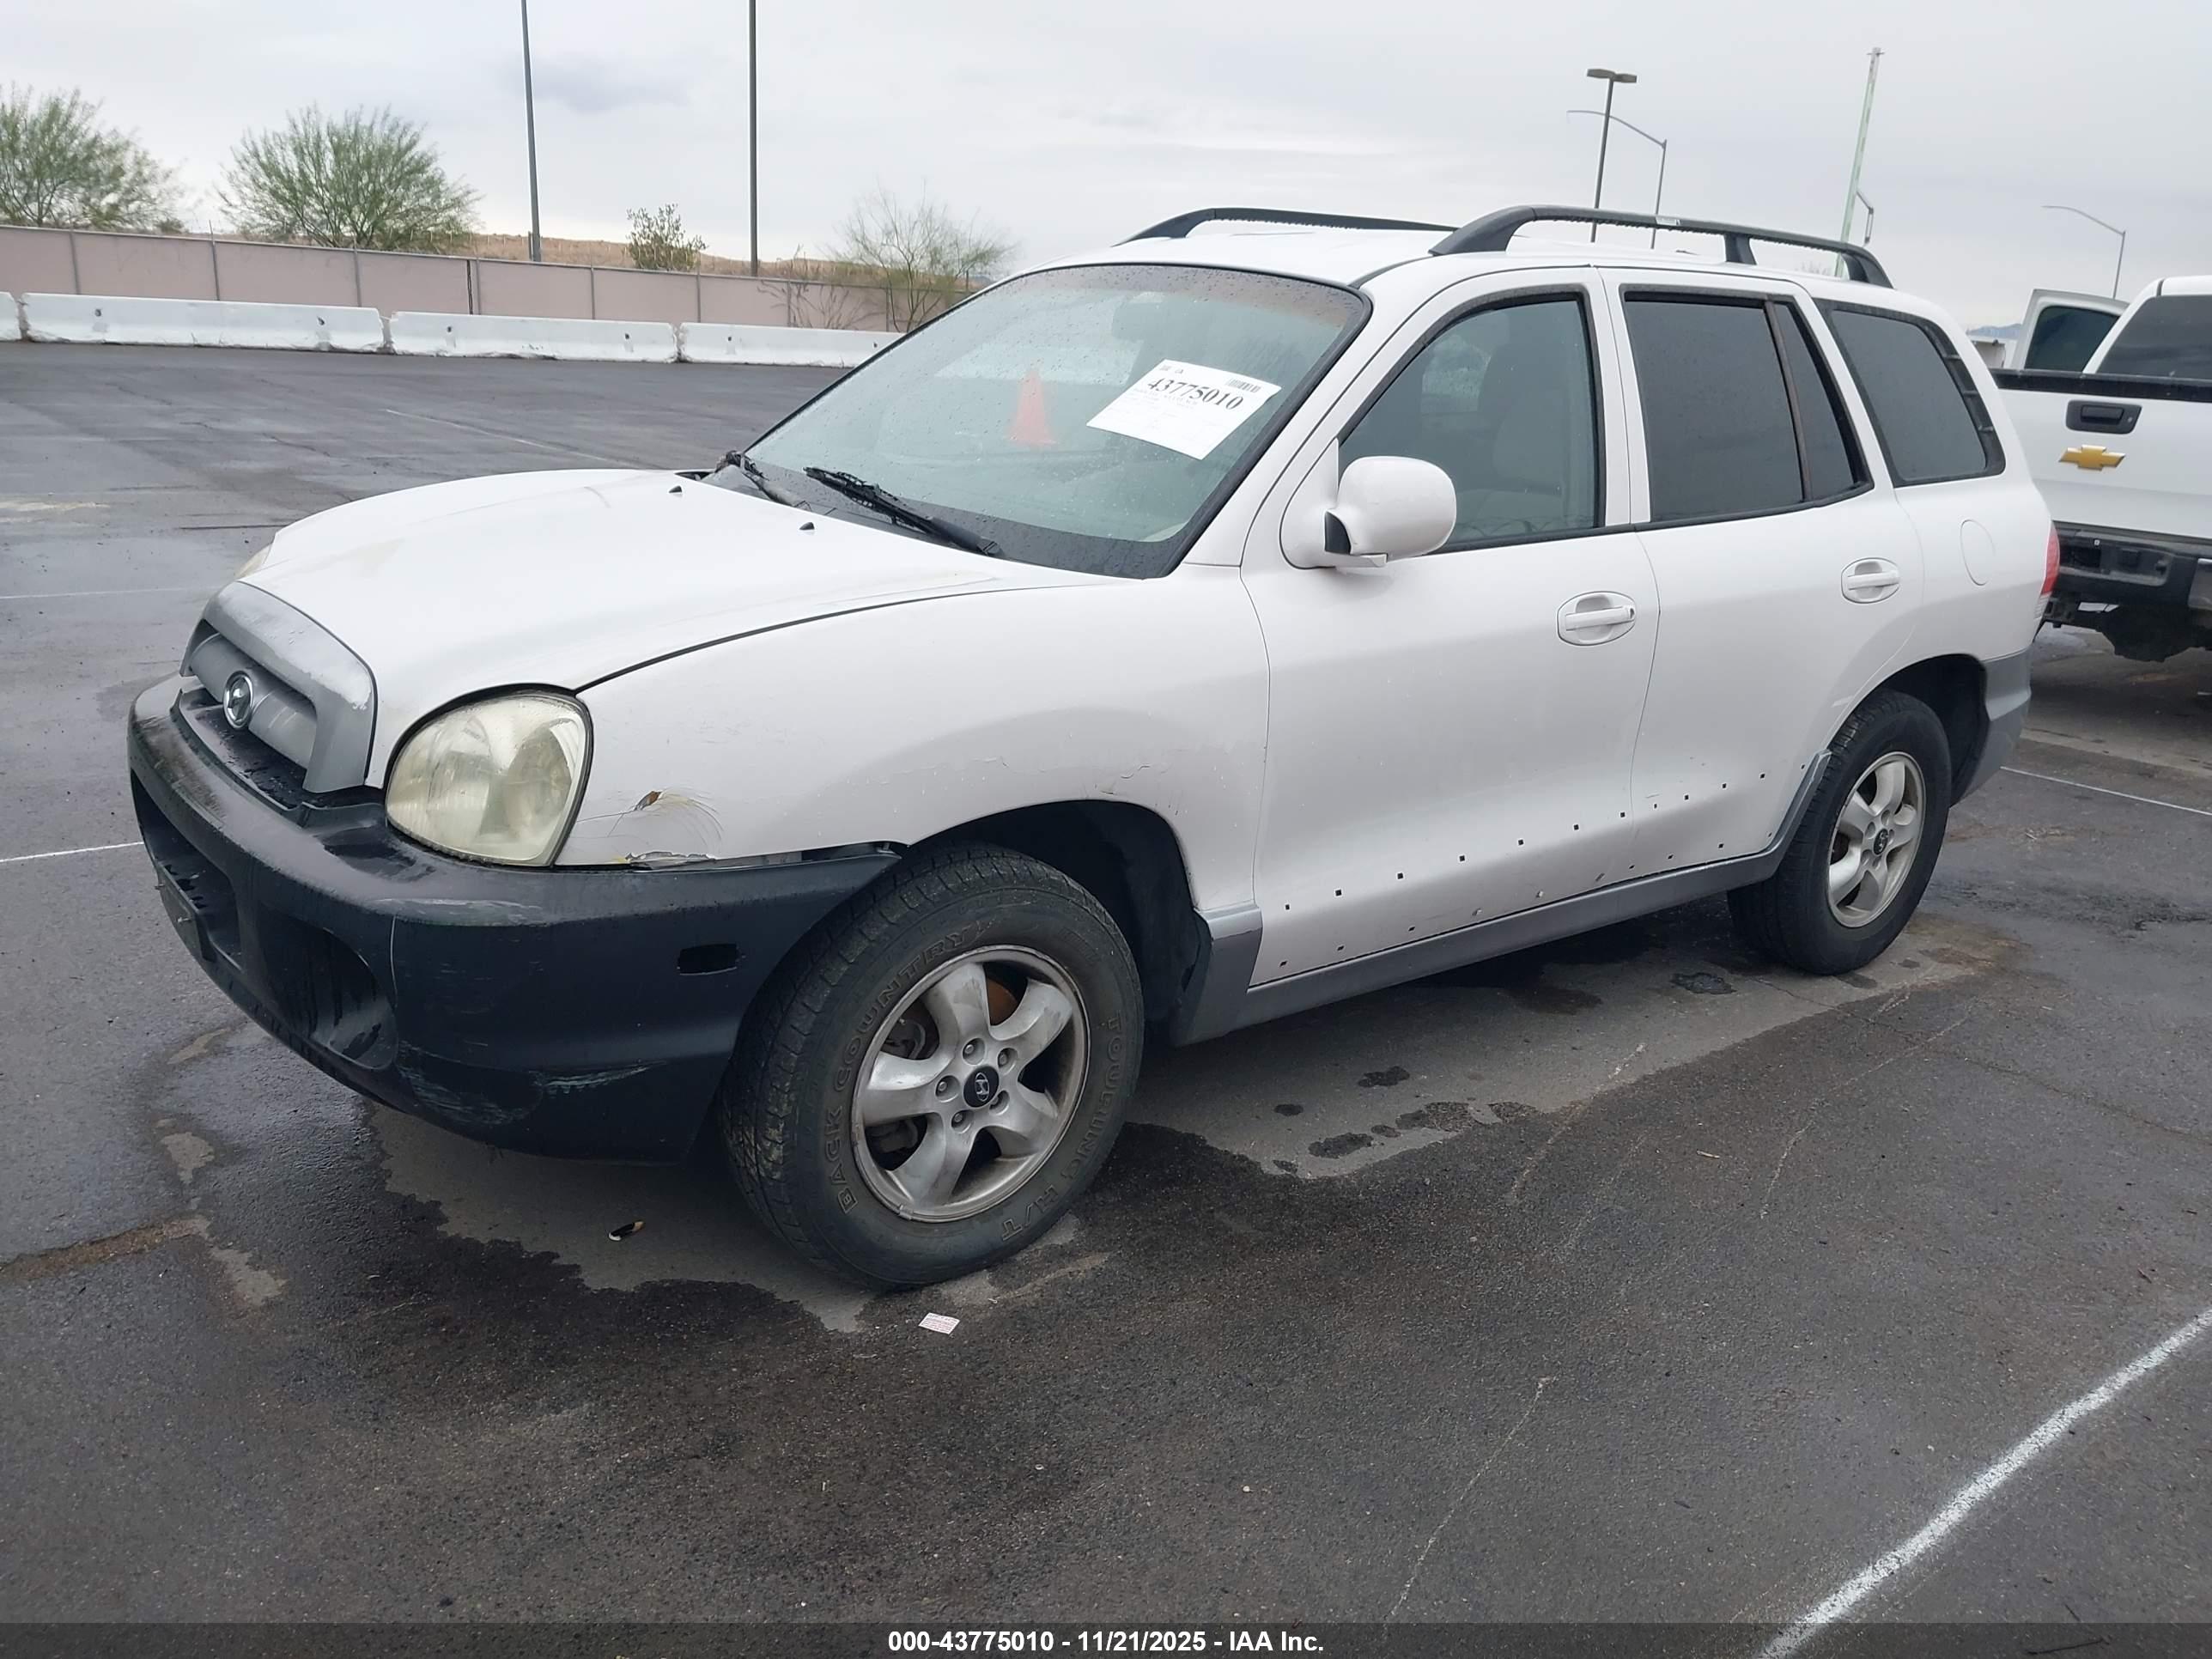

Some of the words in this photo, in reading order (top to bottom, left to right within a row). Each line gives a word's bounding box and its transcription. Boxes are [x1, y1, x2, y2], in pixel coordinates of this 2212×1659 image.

[1147, 378, 1243, 410] 43775010
[834, 922, 972, 1093] COUNTRY
[825, 1104, 859, 1214] BACK
